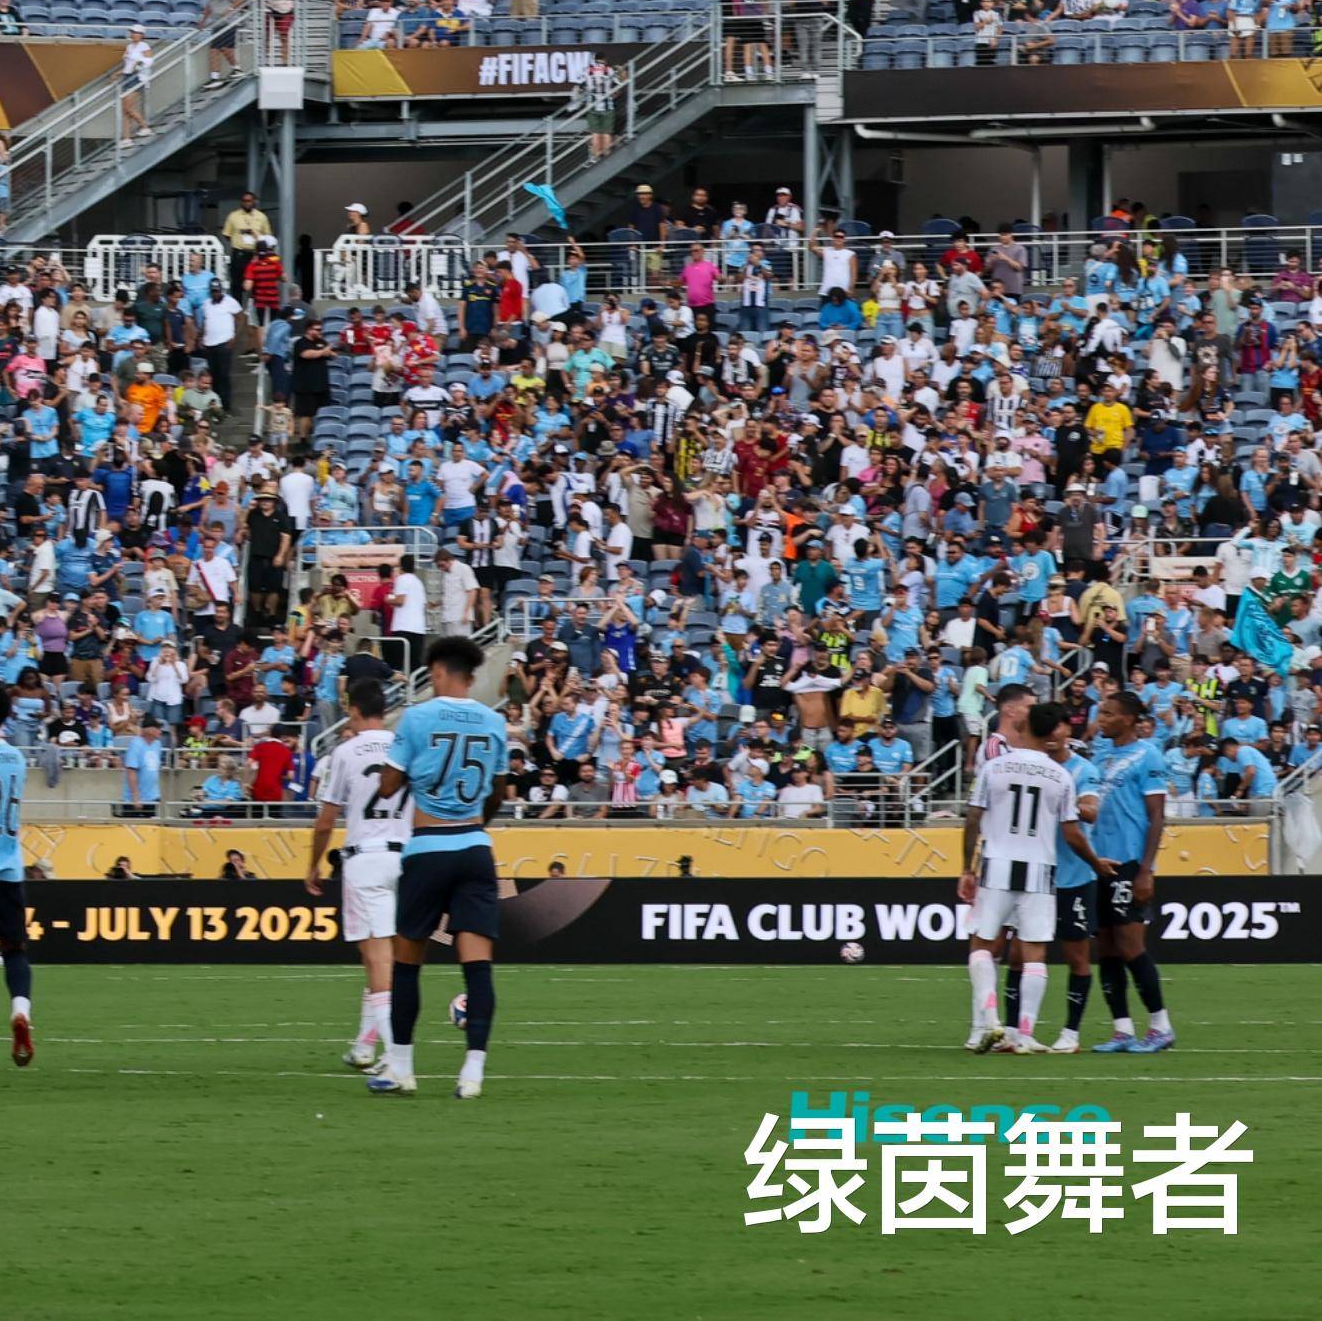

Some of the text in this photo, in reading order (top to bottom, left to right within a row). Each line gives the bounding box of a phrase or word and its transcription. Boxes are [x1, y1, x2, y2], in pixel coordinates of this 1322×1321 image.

[426, 732, 492, 805] 75
[1007, 783, 1042, 838] 11
[77, 906, 180, 941] JULY
[186, 906, 228, 941] 13
[235, 906, 339, 941] 2025
[641, 904, 739, 940] FIFA
[747, 903, 866, 941] CLUB
